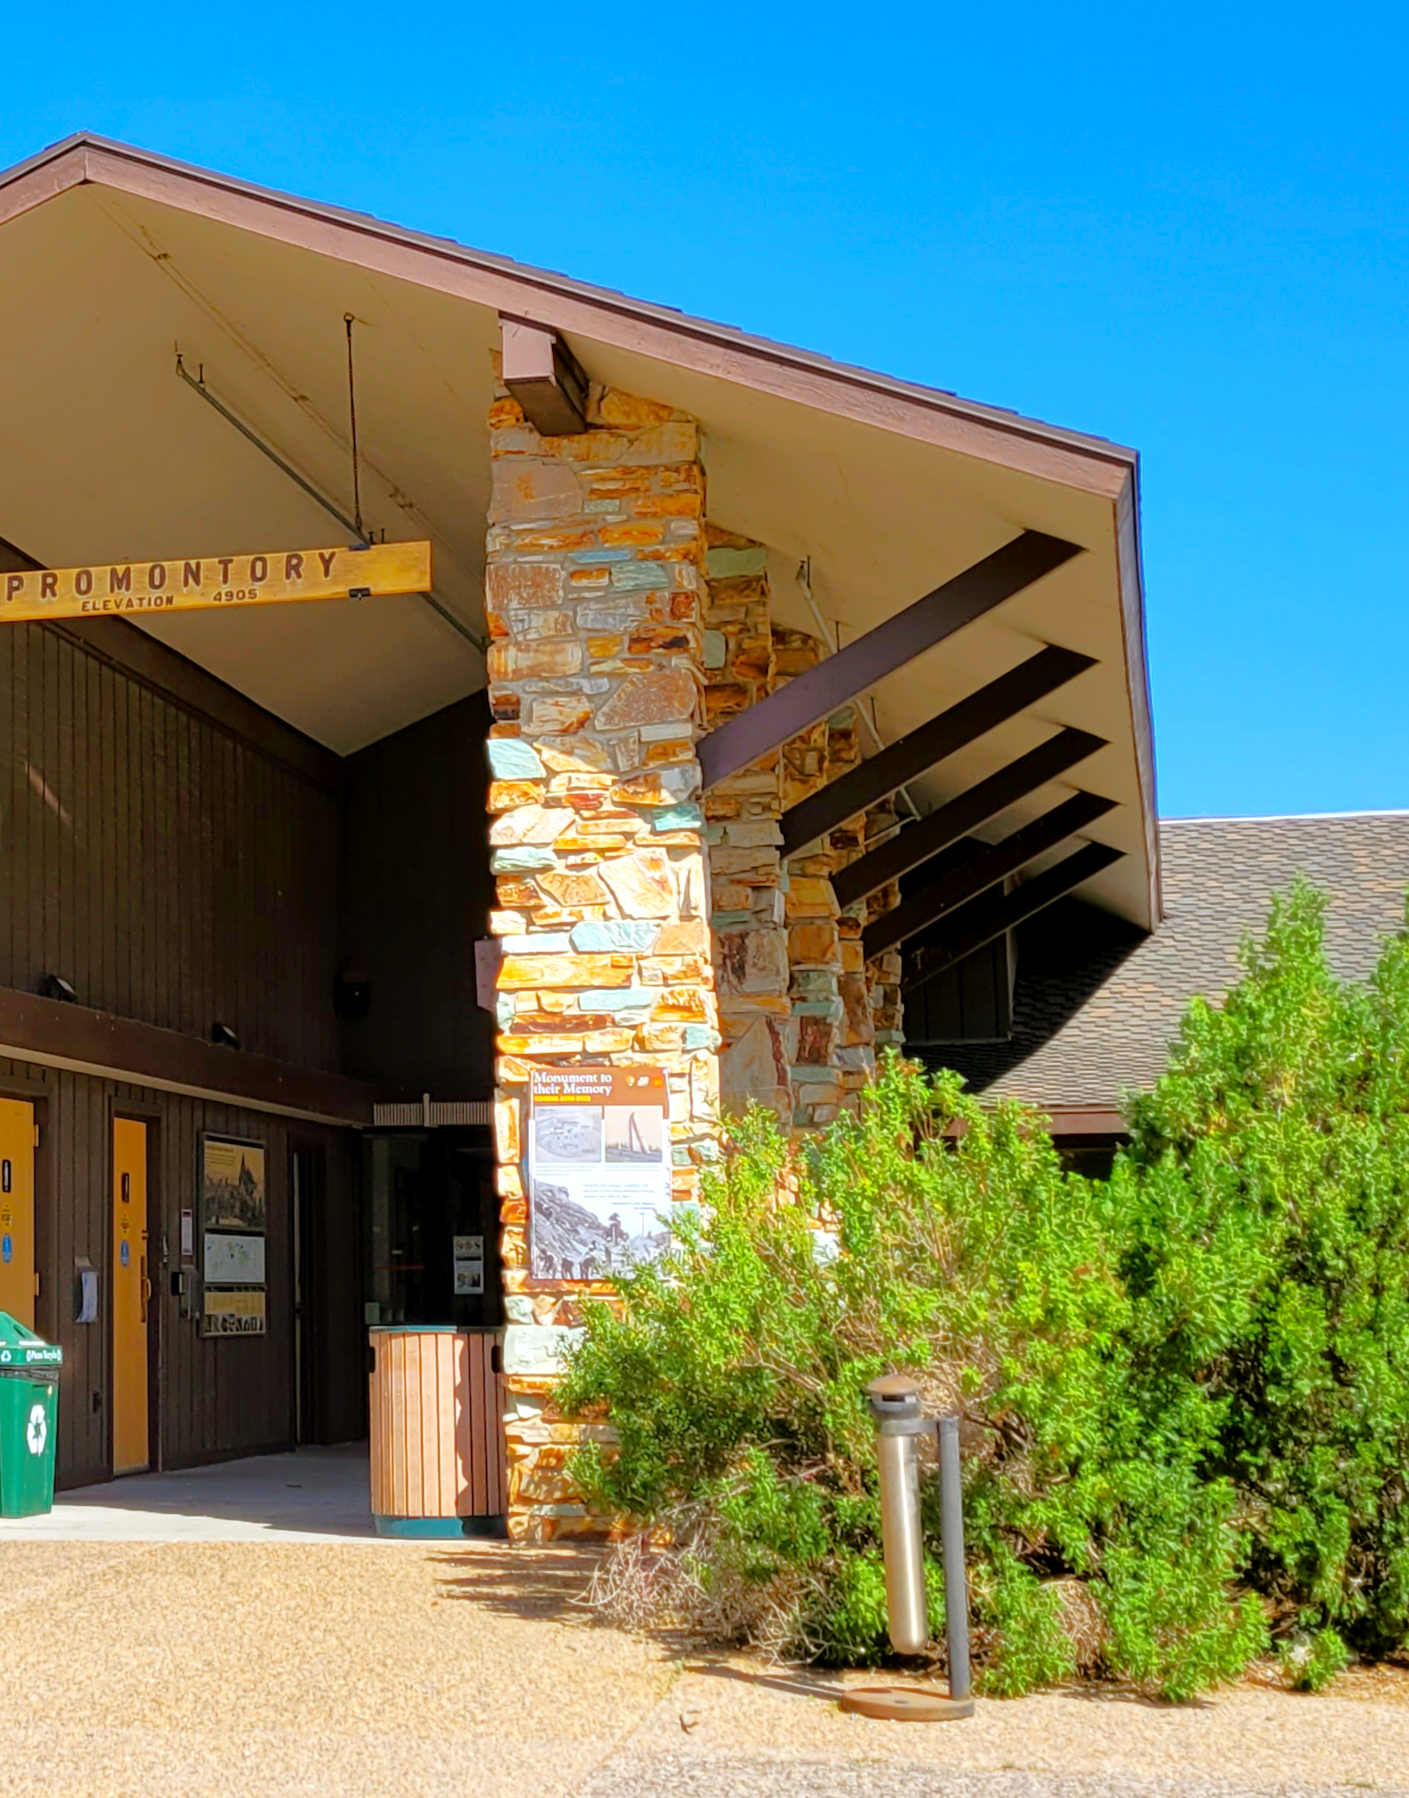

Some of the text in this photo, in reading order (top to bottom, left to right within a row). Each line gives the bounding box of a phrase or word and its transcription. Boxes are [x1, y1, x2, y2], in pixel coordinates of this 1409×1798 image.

[6, 551, 337, 602] PROMONTORY
[80, 588, 258, 613] ELEVATION 4905
[533, 1071, 613, 1083] Monument to
[533, 1082, 613, 1097] their Memory
